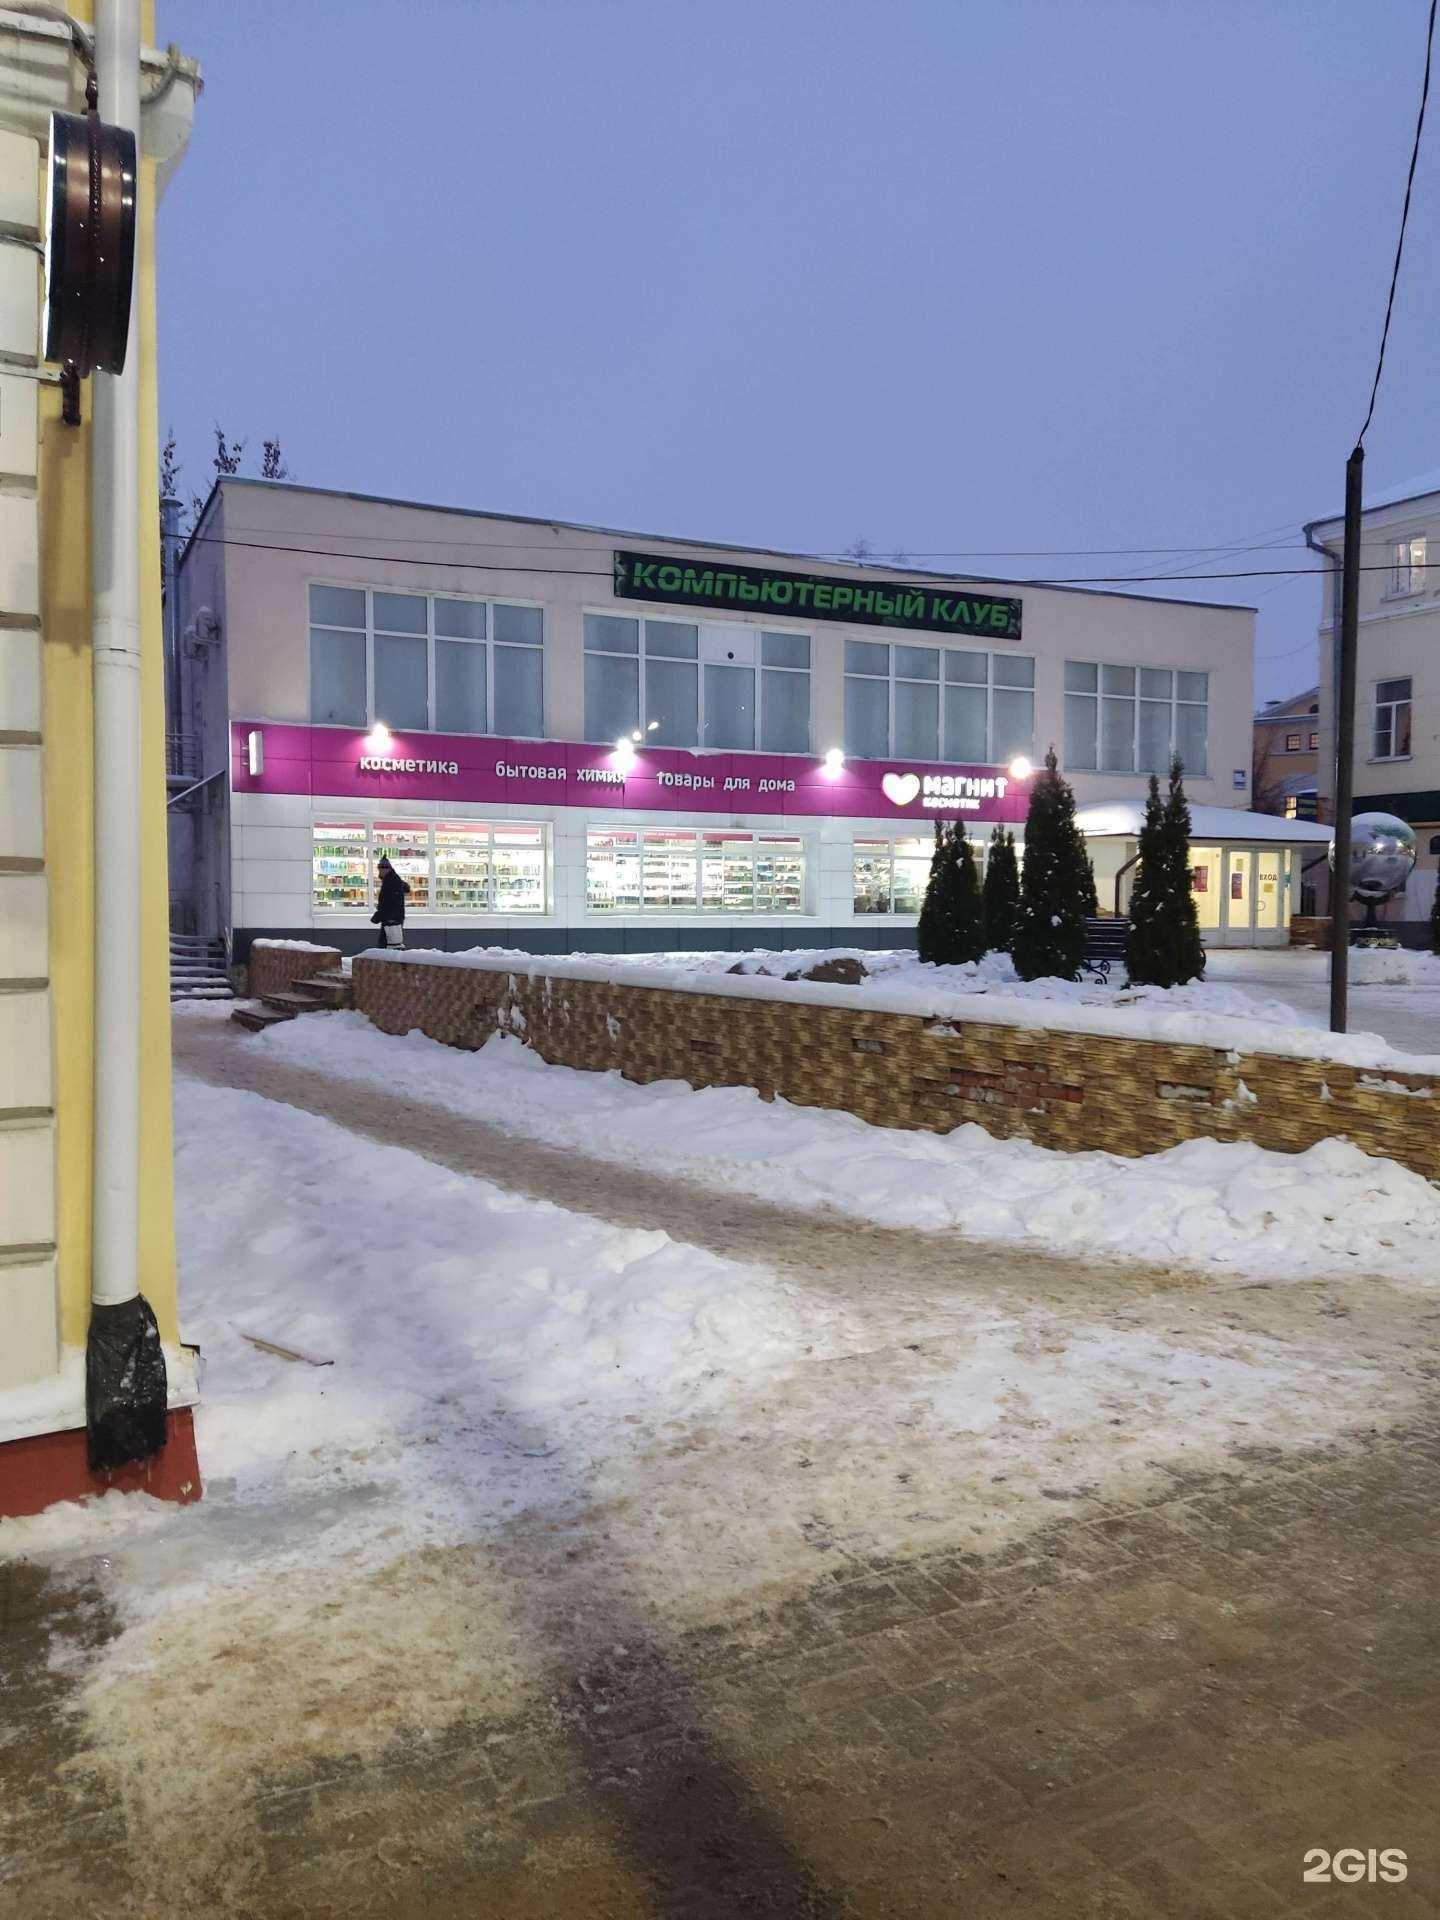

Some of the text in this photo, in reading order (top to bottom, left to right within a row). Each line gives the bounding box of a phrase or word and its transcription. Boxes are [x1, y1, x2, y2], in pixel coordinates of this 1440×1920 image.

[633, 562, 1010, 628] КОМПЬЮТЕРНЫЙ КЛУБ
[360, 756, 459, 775] косметика
[495, 760, 626, 784] бытовая химия
[656, 771, 796, 792] товары для дома
